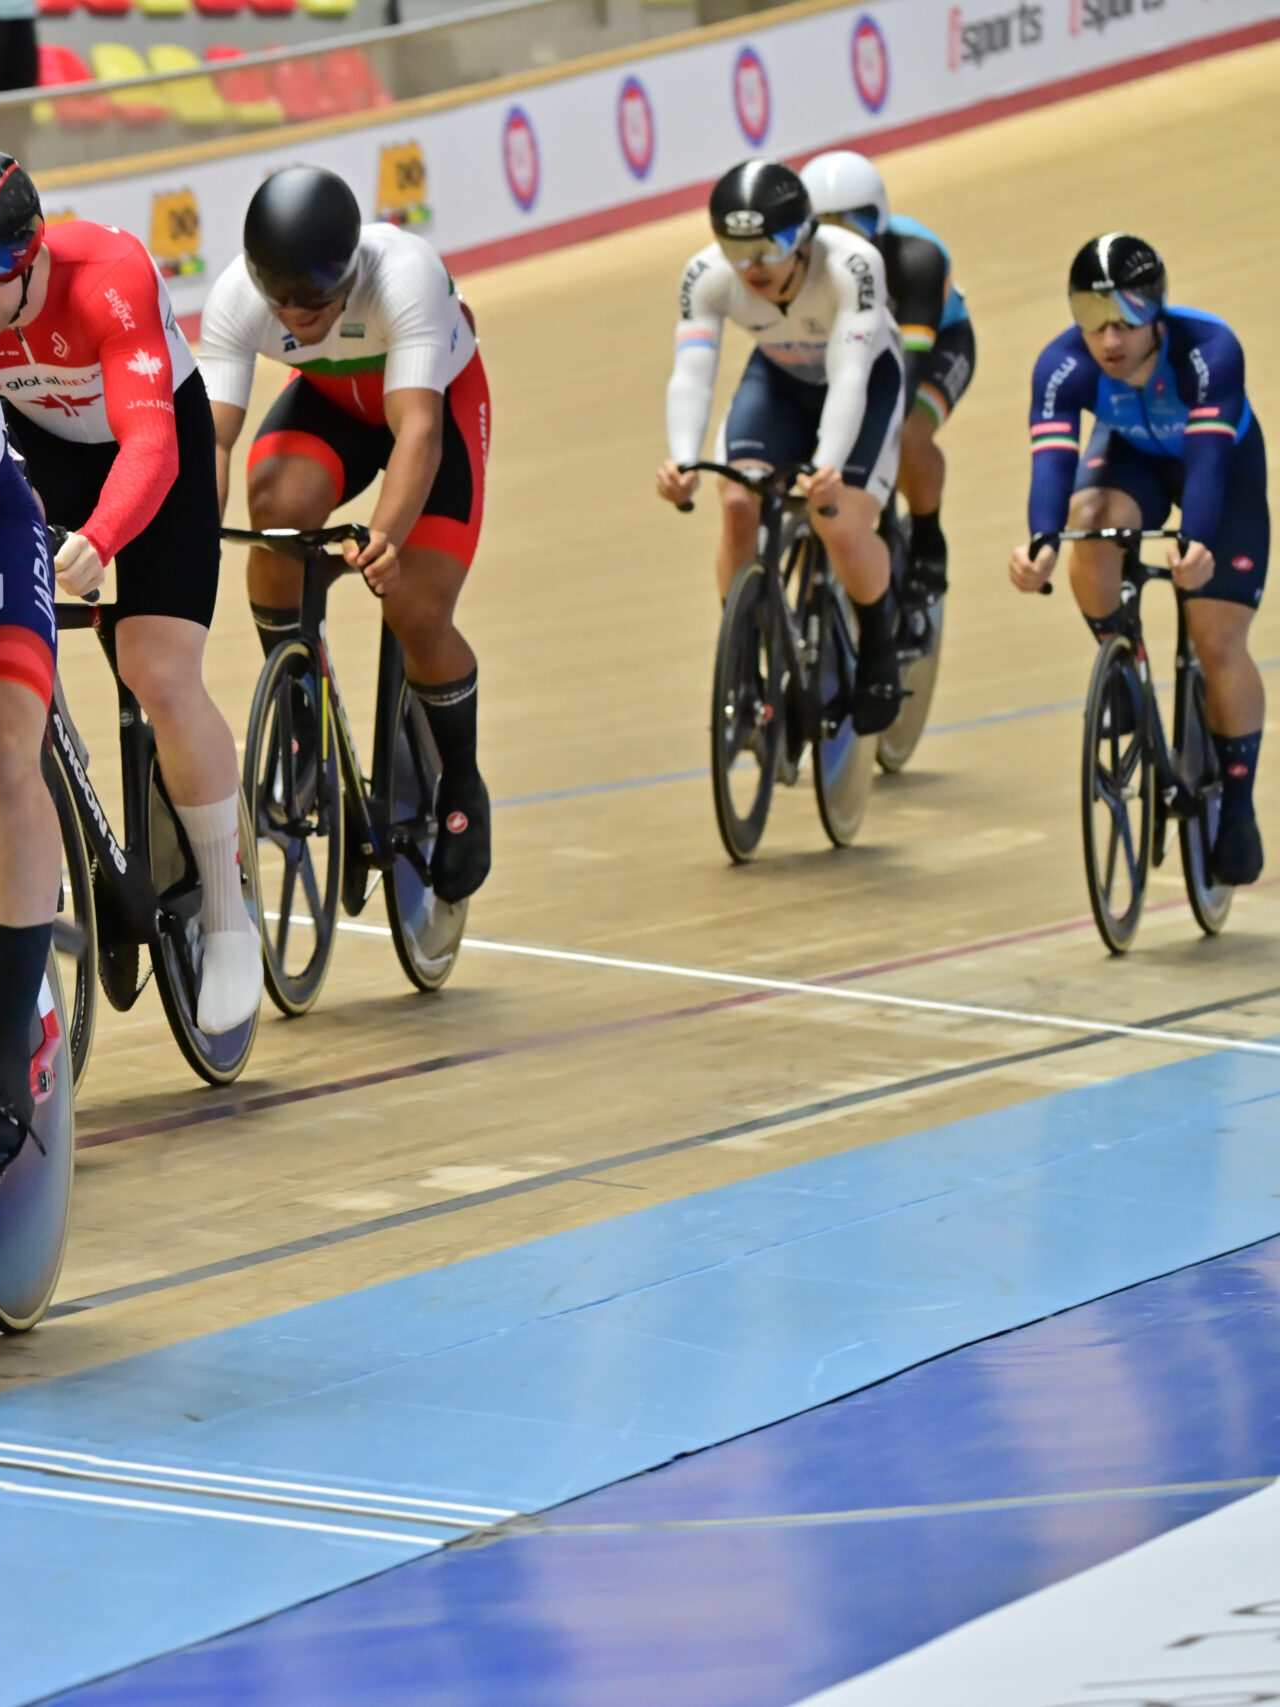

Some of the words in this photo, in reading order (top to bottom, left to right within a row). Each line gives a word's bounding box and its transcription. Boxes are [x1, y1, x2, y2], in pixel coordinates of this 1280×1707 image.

[680, 258, 709, 320] KOREA
[845, 253, 875, 313] KOREA
[53, 713, 108, 838] ARGON
[108, 833, 127, 874] 18
